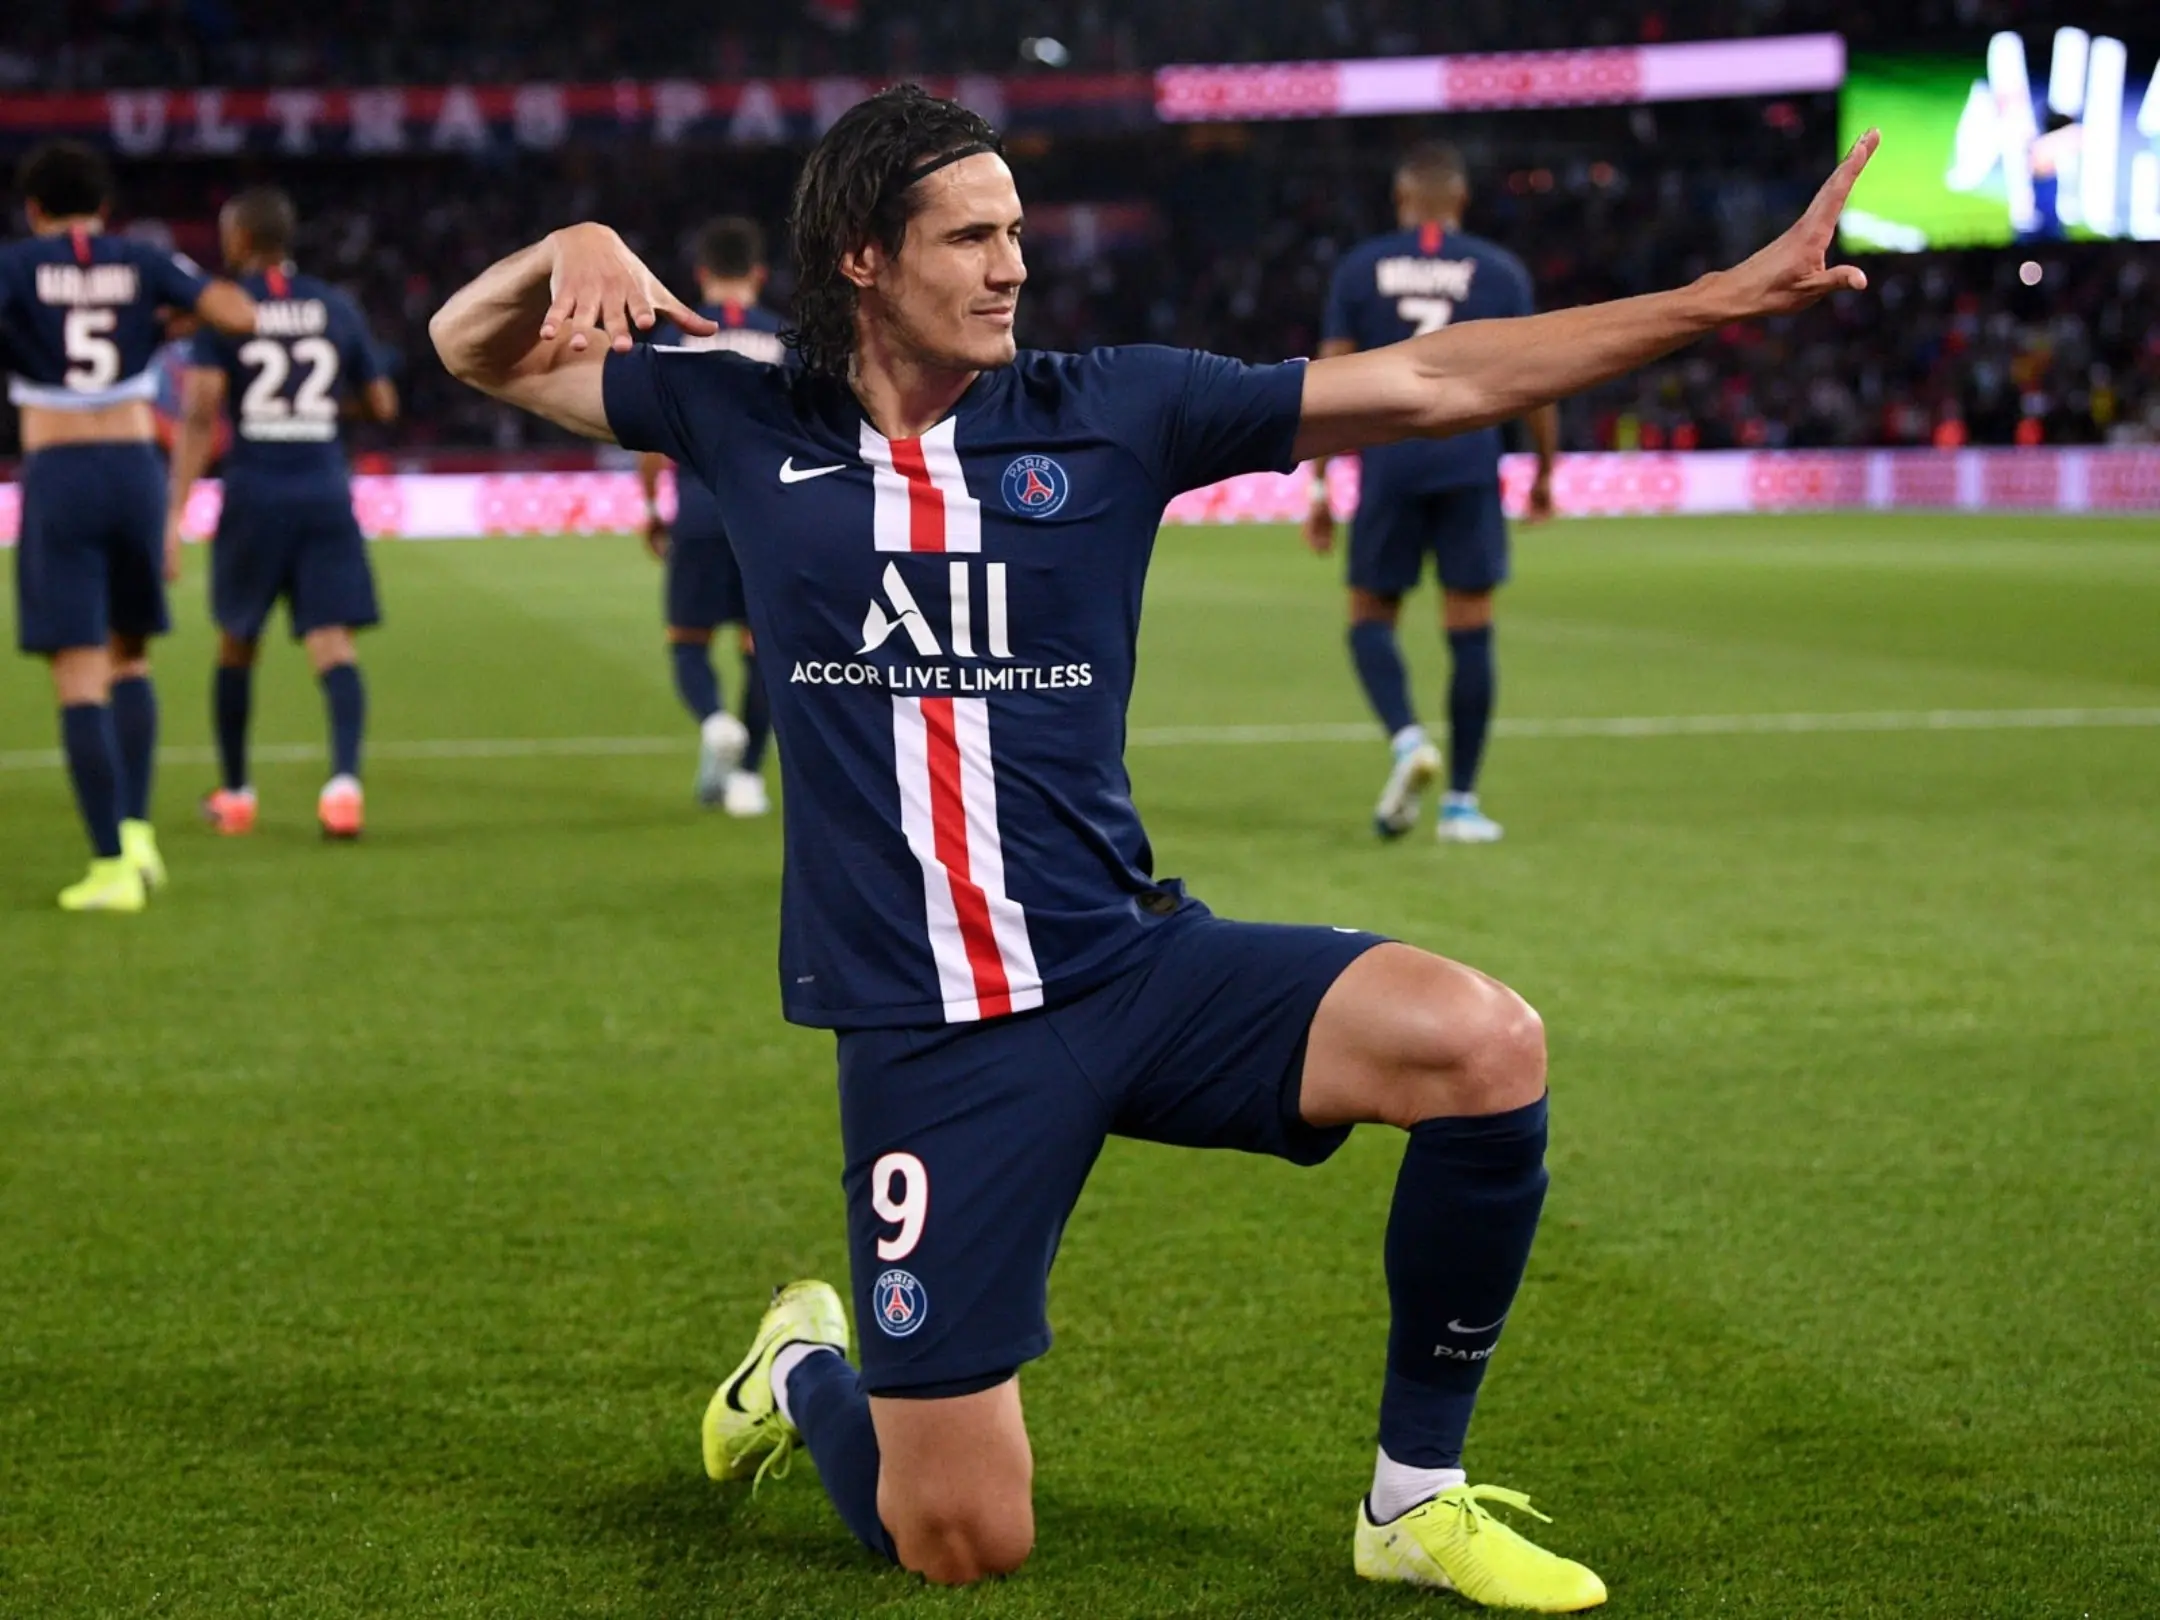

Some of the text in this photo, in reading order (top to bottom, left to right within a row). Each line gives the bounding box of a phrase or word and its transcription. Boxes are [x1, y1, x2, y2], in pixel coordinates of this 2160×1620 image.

[64, 308, 119, 393] 5
[238, 338, 340, 418] 22
[1008, 458, 1051, 478] PARIS
[790, 661, 1093, 691] ACCOR LIVE LIMITLESS
[872, 1151, 929, 1261] 9
[880, 1272, 915, 1290] PARIS
